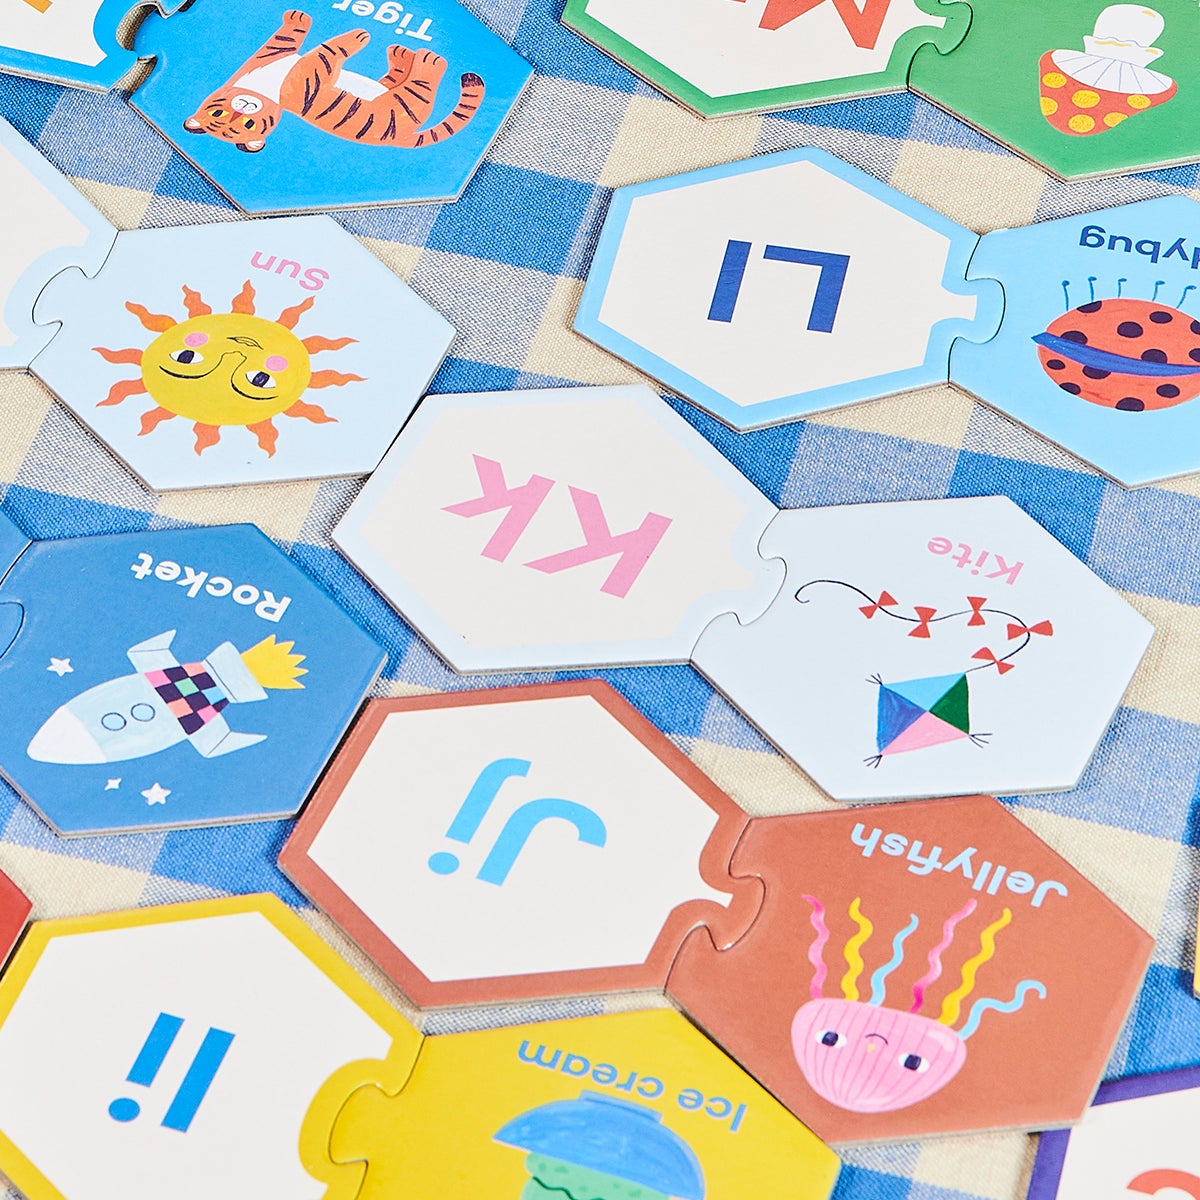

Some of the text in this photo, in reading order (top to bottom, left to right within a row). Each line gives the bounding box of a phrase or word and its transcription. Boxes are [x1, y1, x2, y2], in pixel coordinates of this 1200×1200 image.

[252, 251, 330, 293] Sun
[441, 454, 673, 599] Kk
[927, 536, 1024, 586] Kite
[131, 552, 290, 625] Rocket
[428, 757, 608, 887] Jj
[850, 822, 1069, 909] Jellyfish
[518, 1039, 749, 1134] Ice cream
